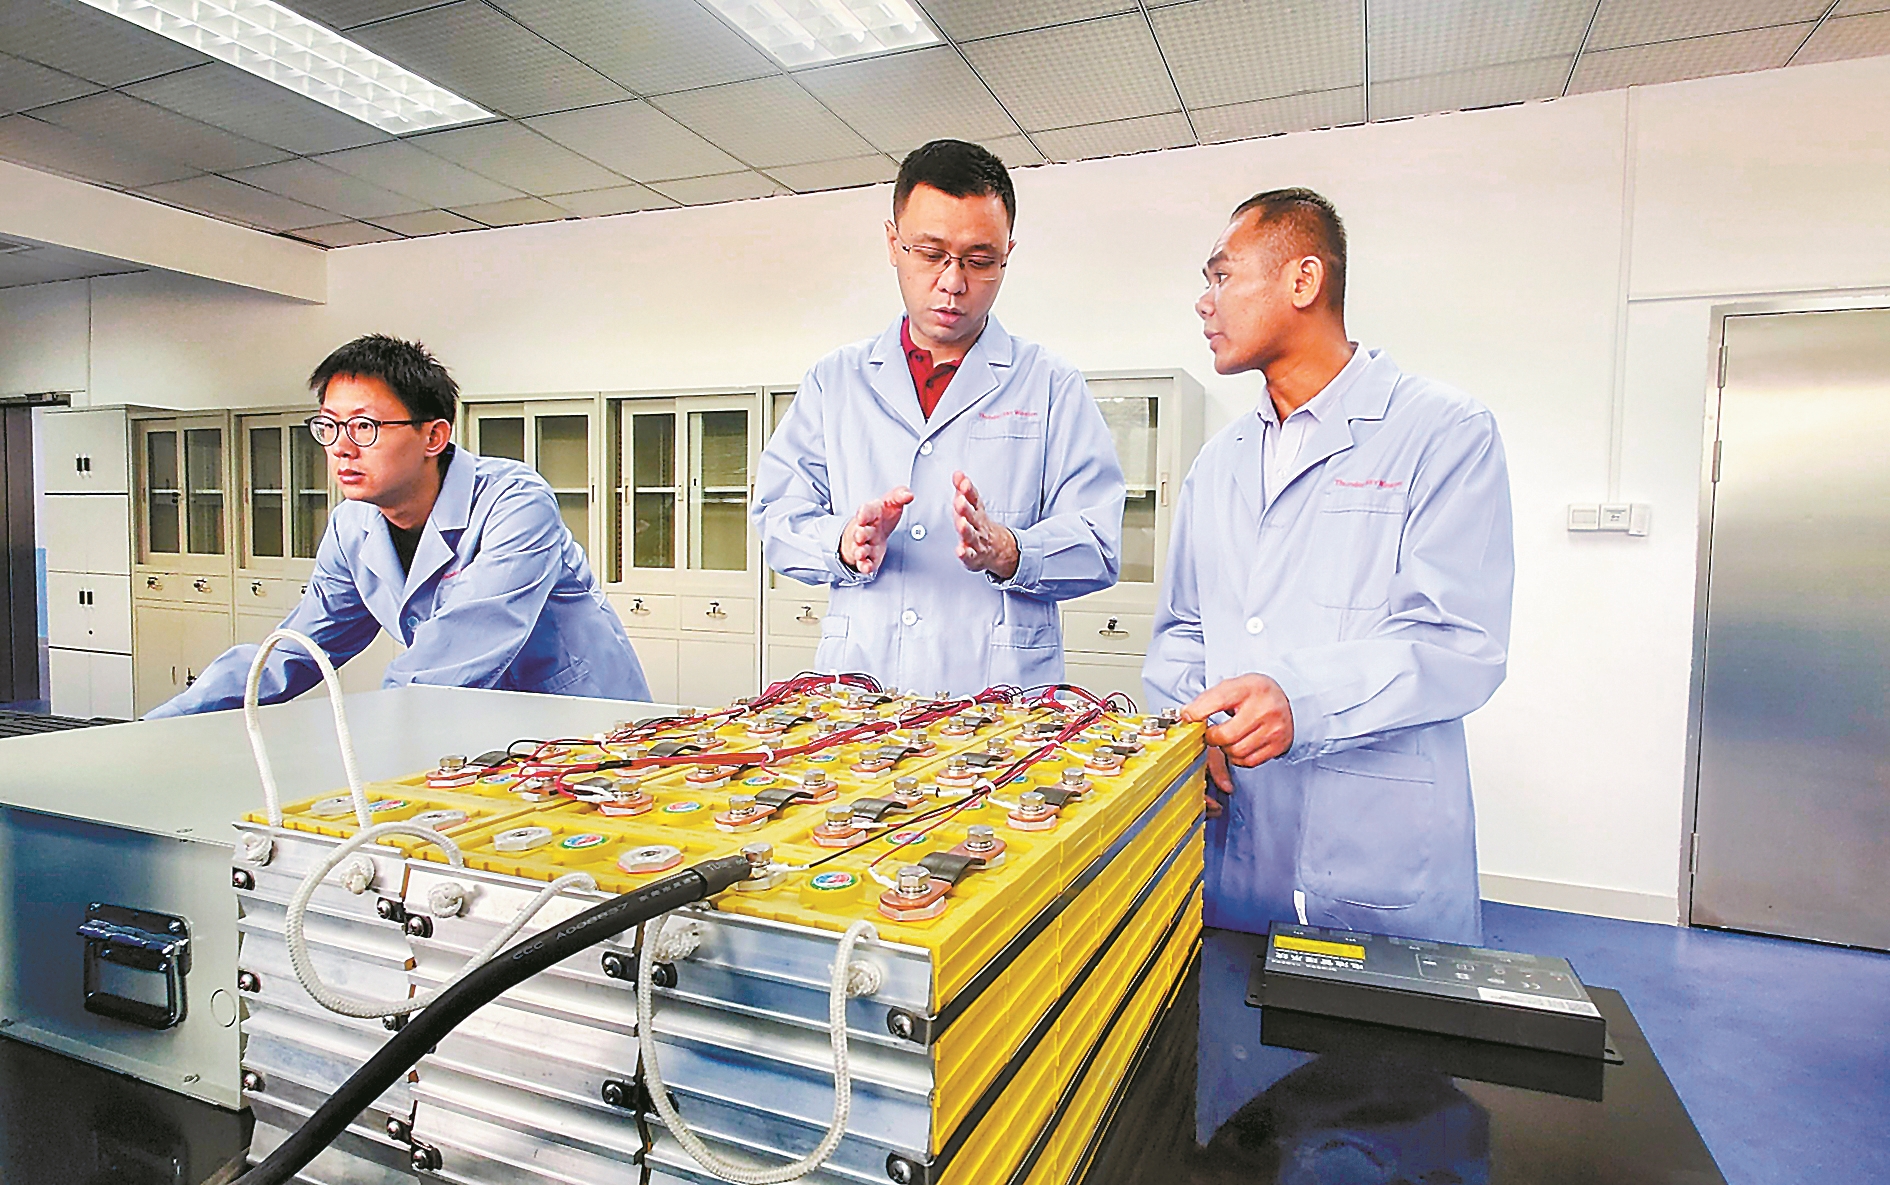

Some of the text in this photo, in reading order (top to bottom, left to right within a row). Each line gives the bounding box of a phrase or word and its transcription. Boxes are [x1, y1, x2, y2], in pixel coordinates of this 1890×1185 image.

[512, 941, 544, 960] CCC
[1274, 952, 1364, 970] 电池管理系统
